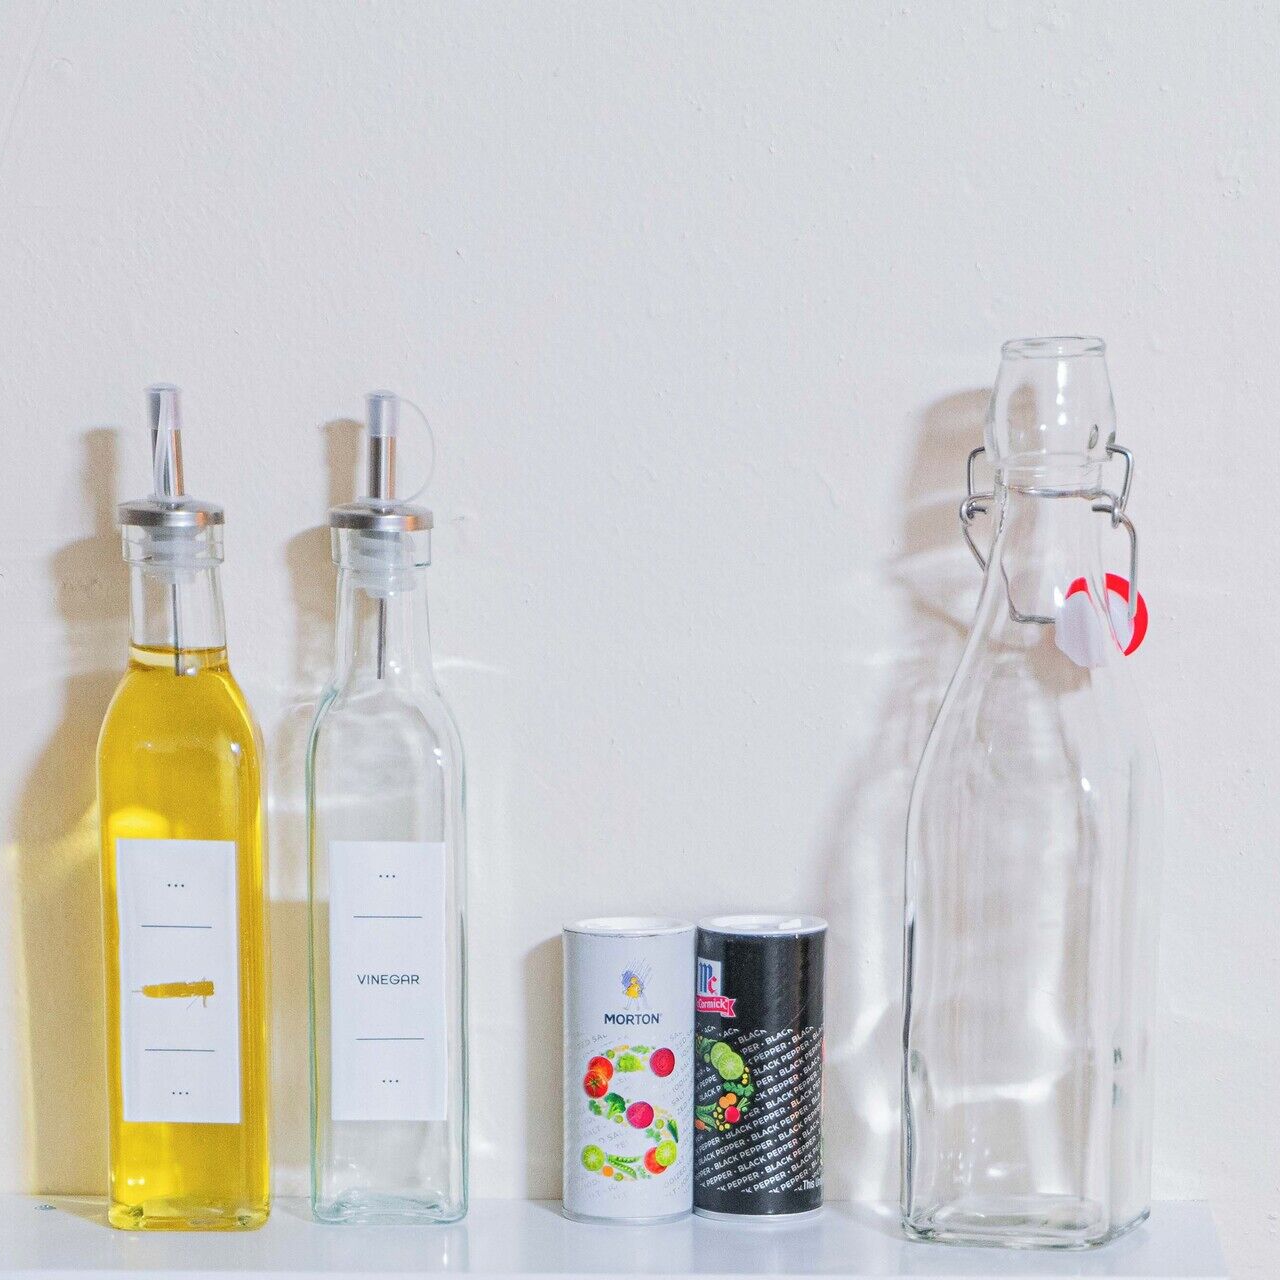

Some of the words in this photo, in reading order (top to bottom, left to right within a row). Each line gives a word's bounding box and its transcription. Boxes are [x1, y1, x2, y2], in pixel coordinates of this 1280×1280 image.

[357, 974, 420, 985] VINEGAR
[604, 1013, 660, 1025] MORTON
[753, 1042, 787, 1062] PEPPER
[781, 1041, 809, 1062] PEPPER
[779, 1057, 804, 1077] BLACK
[765, 1090, 794, 1109] BLACK
[793, 1070, 818, 1094] PEPPER
[767, 1074, 799, 1096] PEPPER
[753, 1107, 786, 1128] PEPPER
[790, 1089, 813, 1108] BLACK
[713, 1154, 739, 1170] BLACK
[740, 1139, 773, 1158] PEPPER
[778, 1121, 803, 1141] BLACK
[716, 1139, 745, 1156] PEPPER
[751, 1124, 779, 1140] BLACK
[780, 1105, 809, 1127] PEPPER
[706, 1170, 733, 1187] PEPPER
[737, 1155, 766, 1173] BLACK
[766, 1138, 799, 1160] PEPPER
[727, 1171, 759, 1189] PEPPER
[765, 1154, 793, 1174] BLACK
[792, 1135, 816, 1158] PEPPER
[753, 1171, 787, 1192] PEPPER
[791, 1152, 813, 1172] BLACK
[780, 1169, 808, 1191] PEPPER
